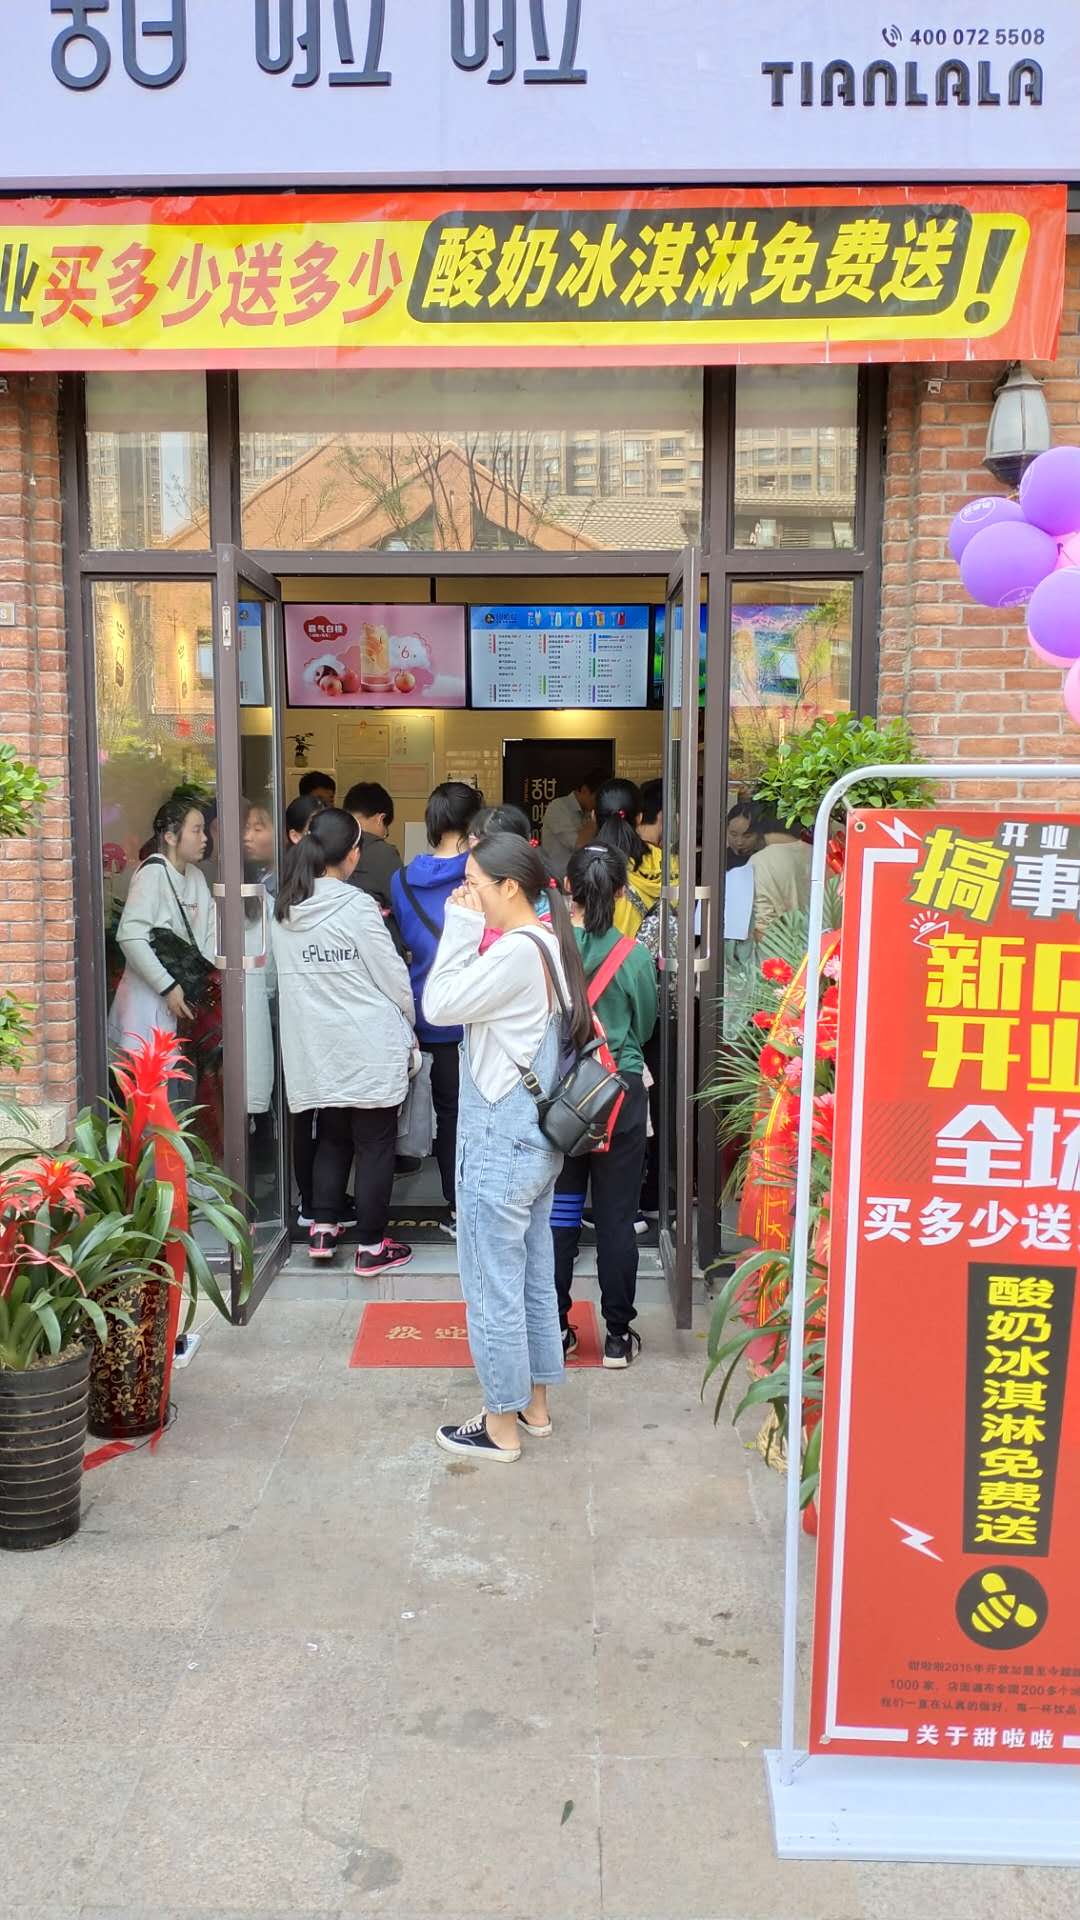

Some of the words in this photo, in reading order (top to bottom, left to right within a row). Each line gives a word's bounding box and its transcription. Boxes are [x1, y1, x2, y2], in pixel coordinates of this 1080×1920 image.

[910, 28, 947, 46] 400
[953, 28, 989, 46] 072
[995, 27, 1046, 46] 5508
[761, 59, 1044, 107] TIANLALA
[974, 1276, 1055, 1546] 酸奶冰淇淋免费送
[915, 1724, 1055, 1750] 关于甜啦啦
